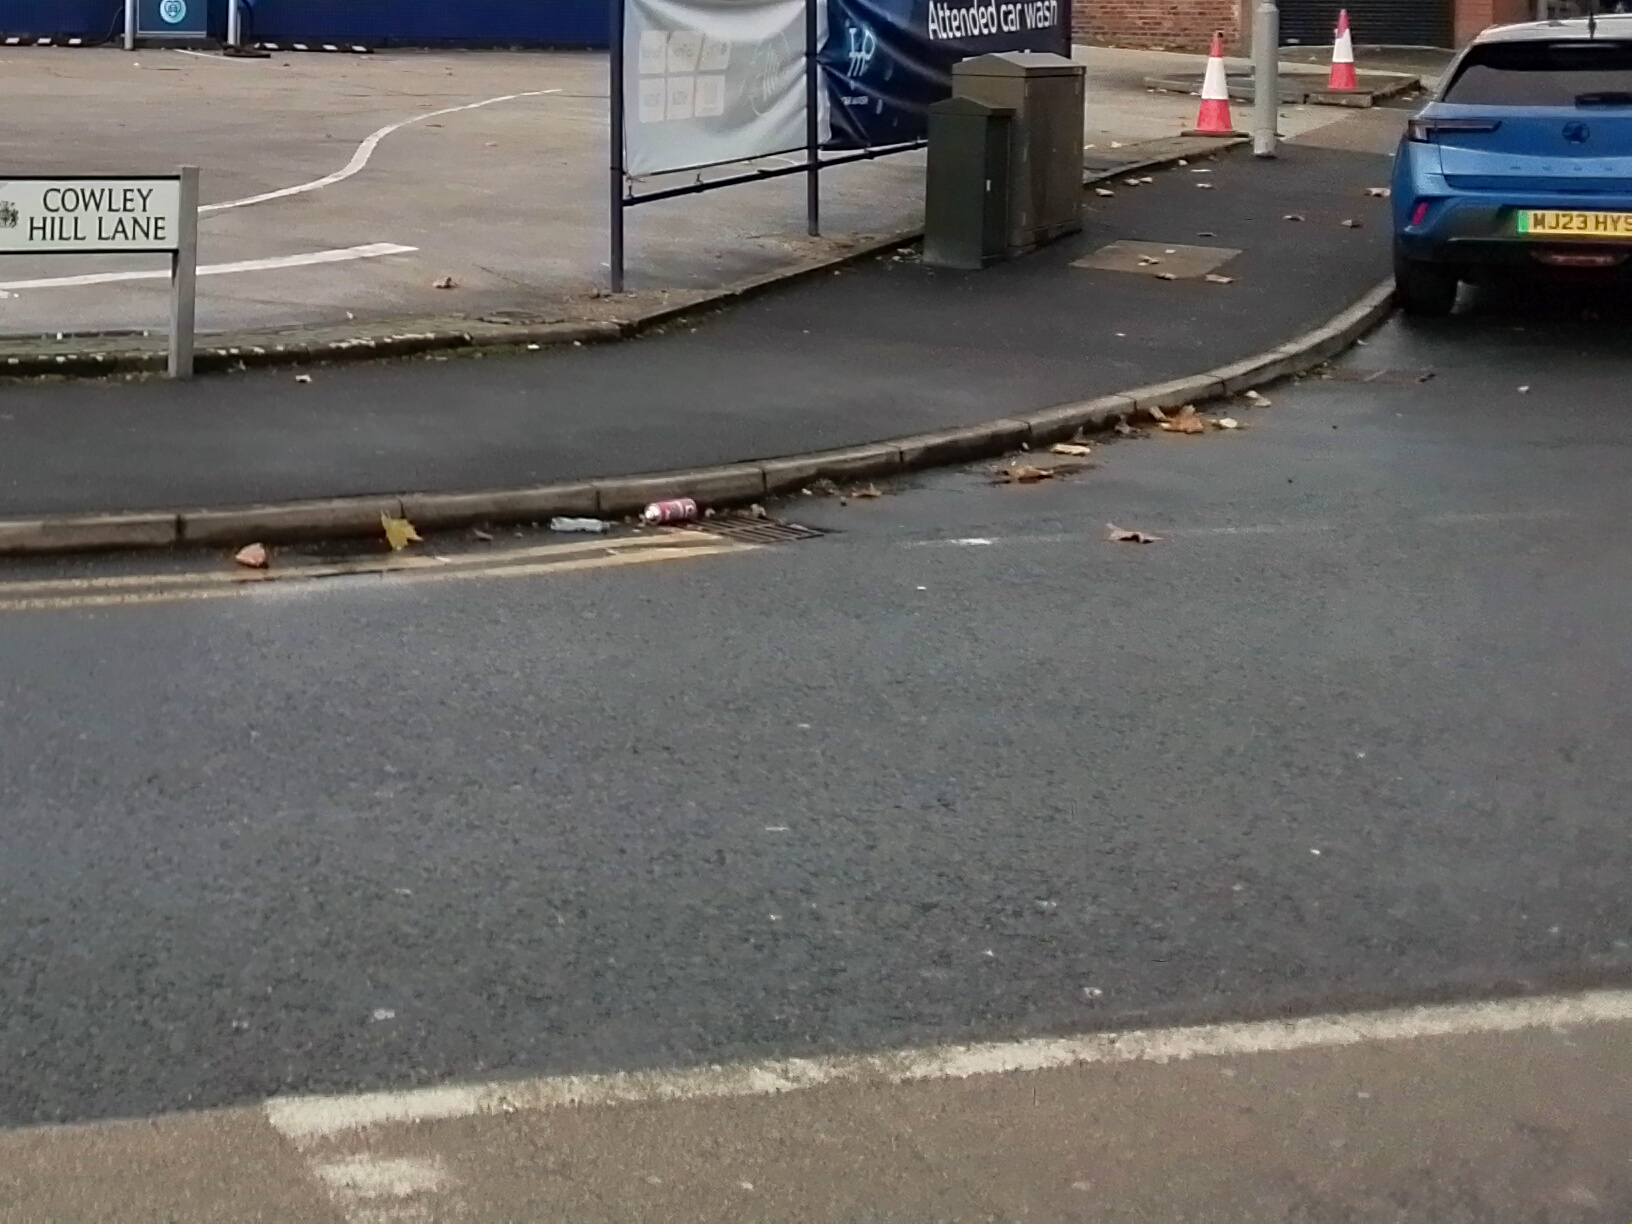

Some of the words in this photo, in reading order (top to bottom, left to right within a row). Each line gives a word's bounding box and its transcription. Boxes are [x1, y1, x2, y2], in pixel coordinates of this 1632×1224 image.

[1000, 2, 1022, 34] car
[42, 187, 154, 213] COWLEY
[28, 216, 87, 242] HILL
[96, 216, 167, 241] LANE
[1532, 212, 1588, 231] MJ23
